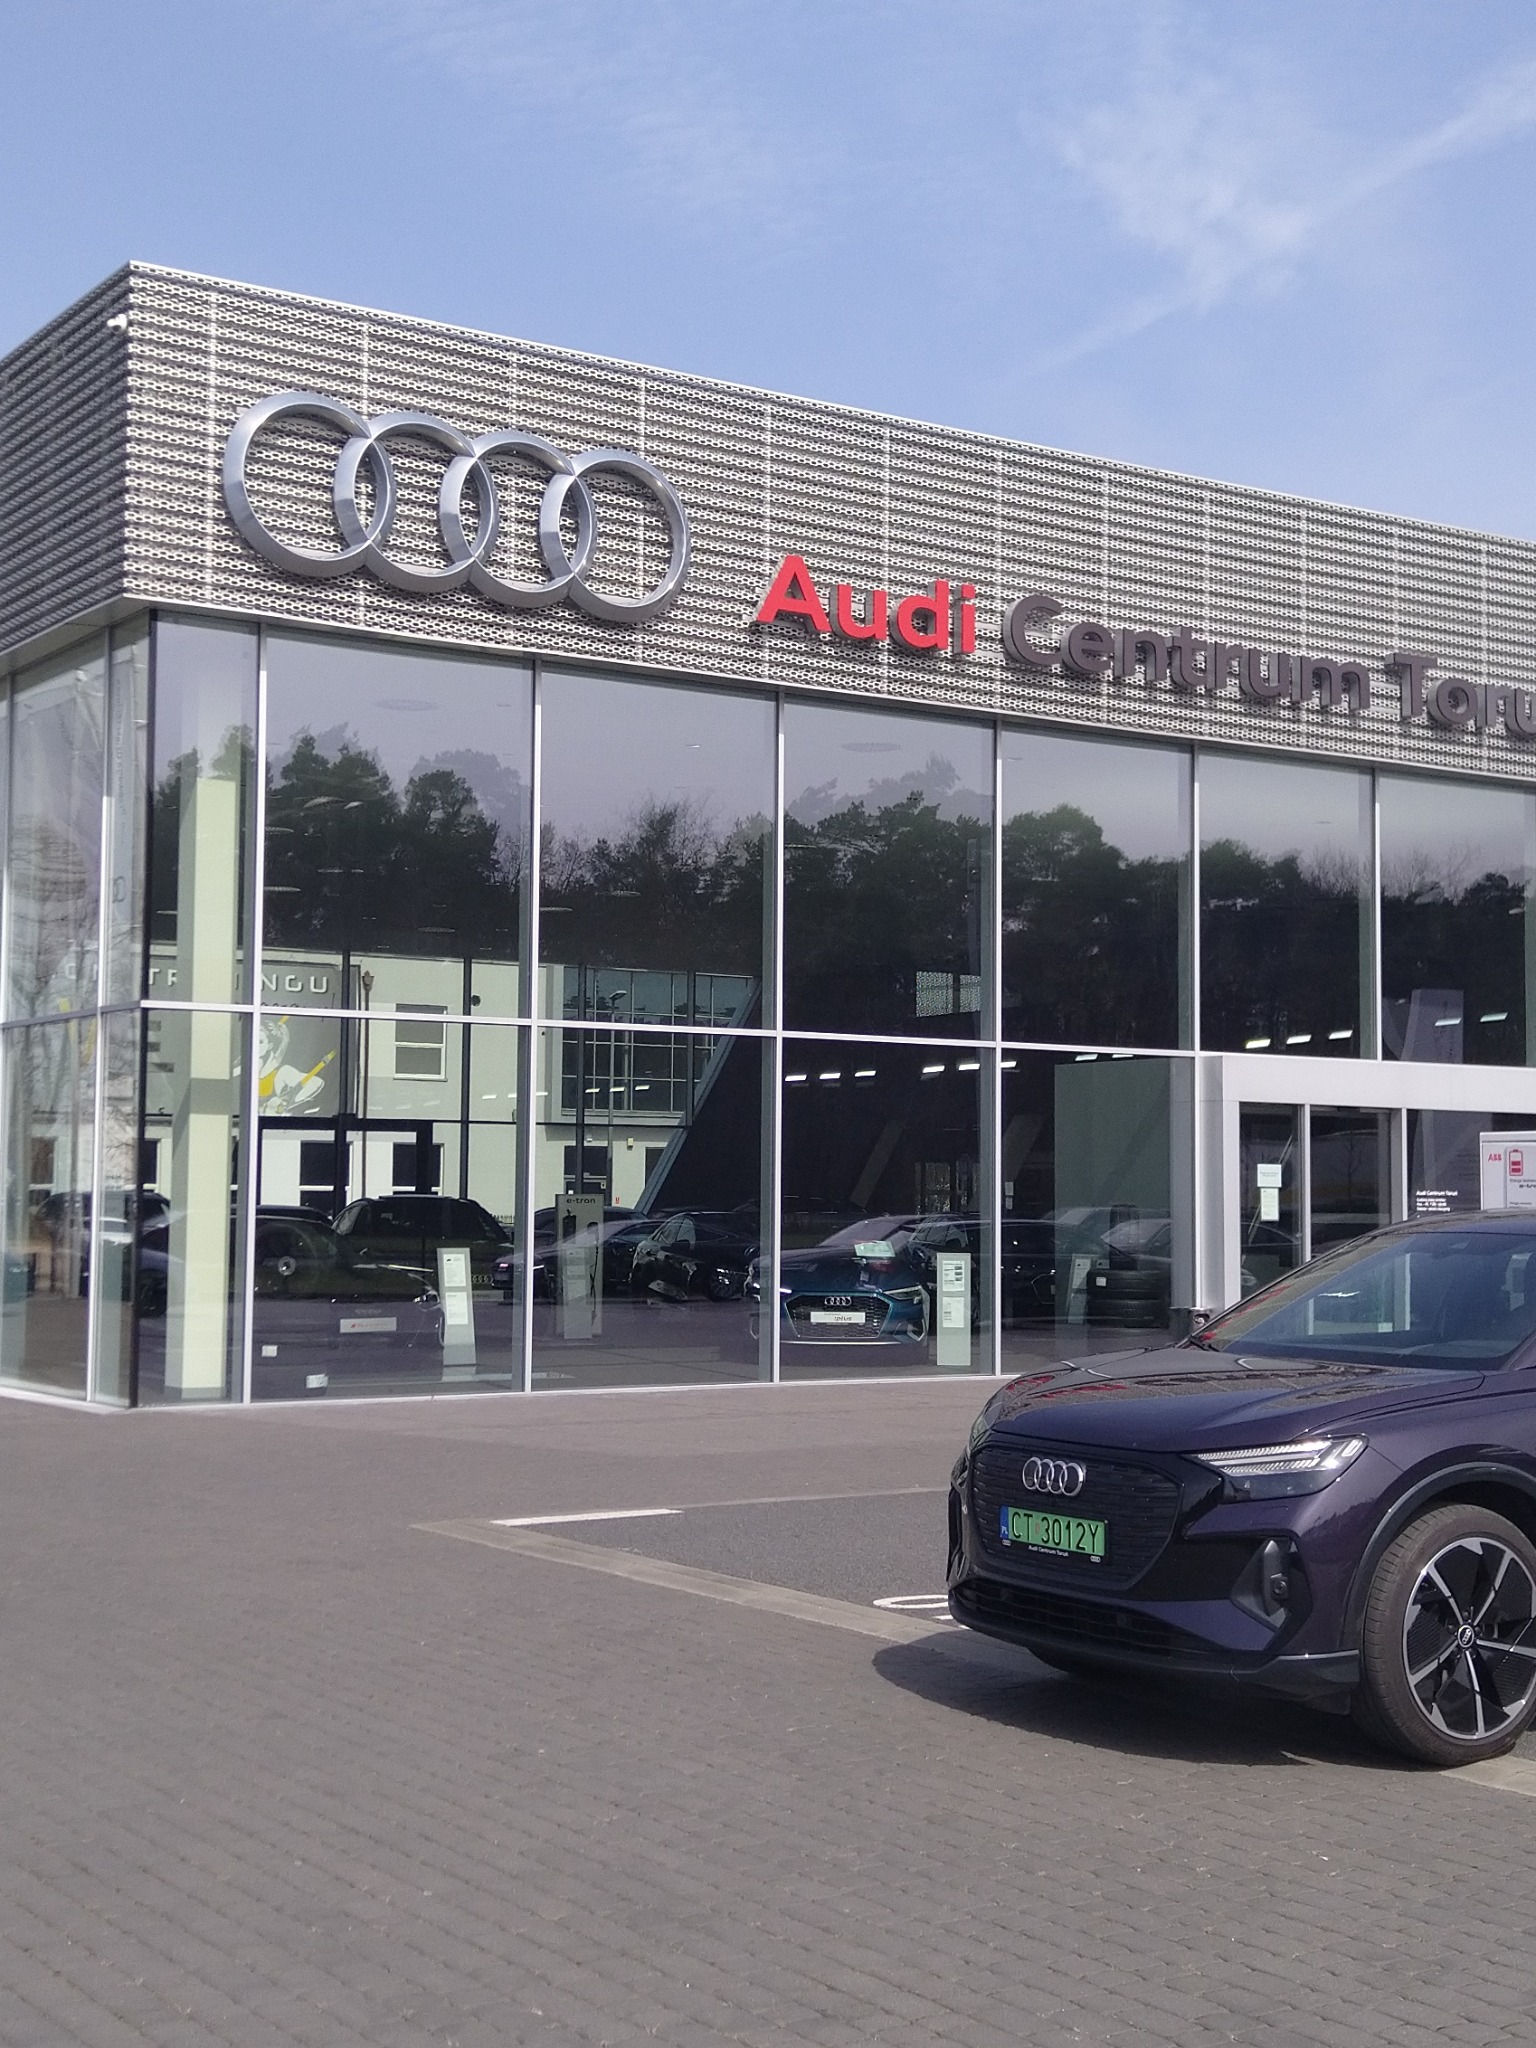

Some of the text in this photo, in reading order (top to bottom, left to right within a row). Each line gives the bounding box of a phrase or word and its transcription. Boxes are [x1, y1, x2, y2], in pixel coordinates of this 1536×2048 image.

[752, 554, 1536, 735] Audi Centrum Toru
[1487, 1153, 1502, 1161] ABB
[1001, 1525, 1008, 1535] PL
[1011, 1511, 1099, 1553] CT 3012Y
